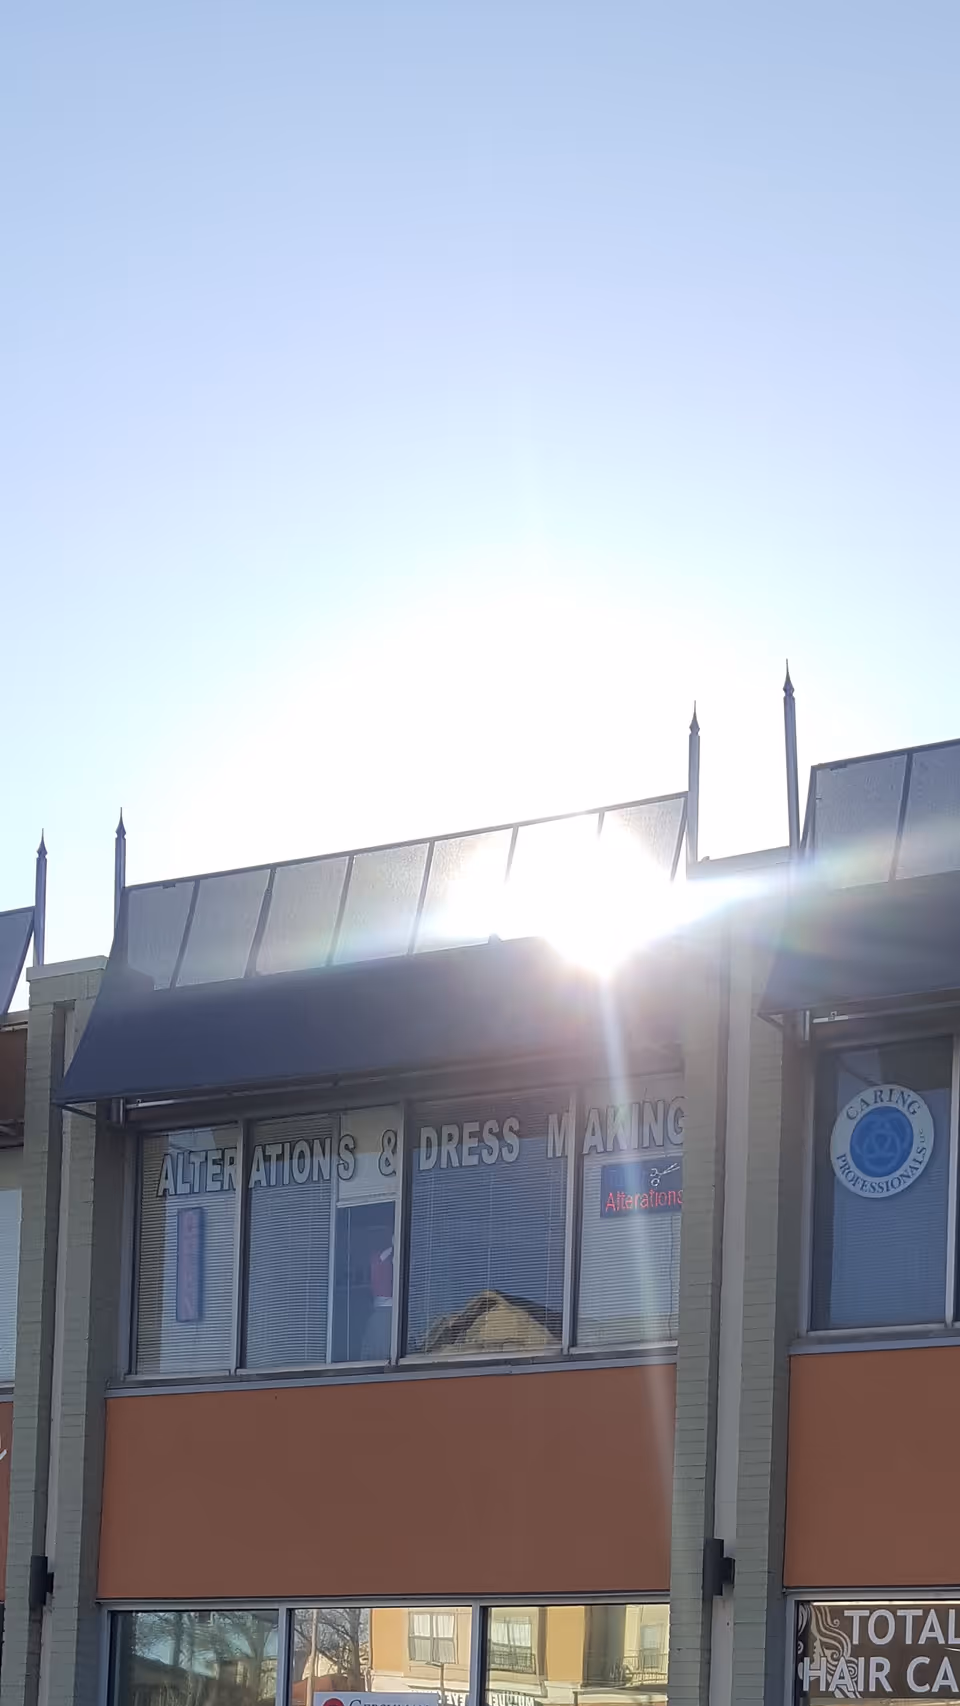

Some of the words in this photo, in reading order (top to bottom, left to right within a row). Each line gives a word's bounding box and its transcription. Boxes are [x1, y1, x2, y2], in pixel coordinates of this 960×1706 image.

[846, 1088, 921, 1120] CARING
[378, 1129, 397, 1177] &
[418, 1116, 521, 1171] DRESS
[836, 1146, 927, 1194] PROFESSIONALS
[802, 1655, 893, 1693] HAIR
